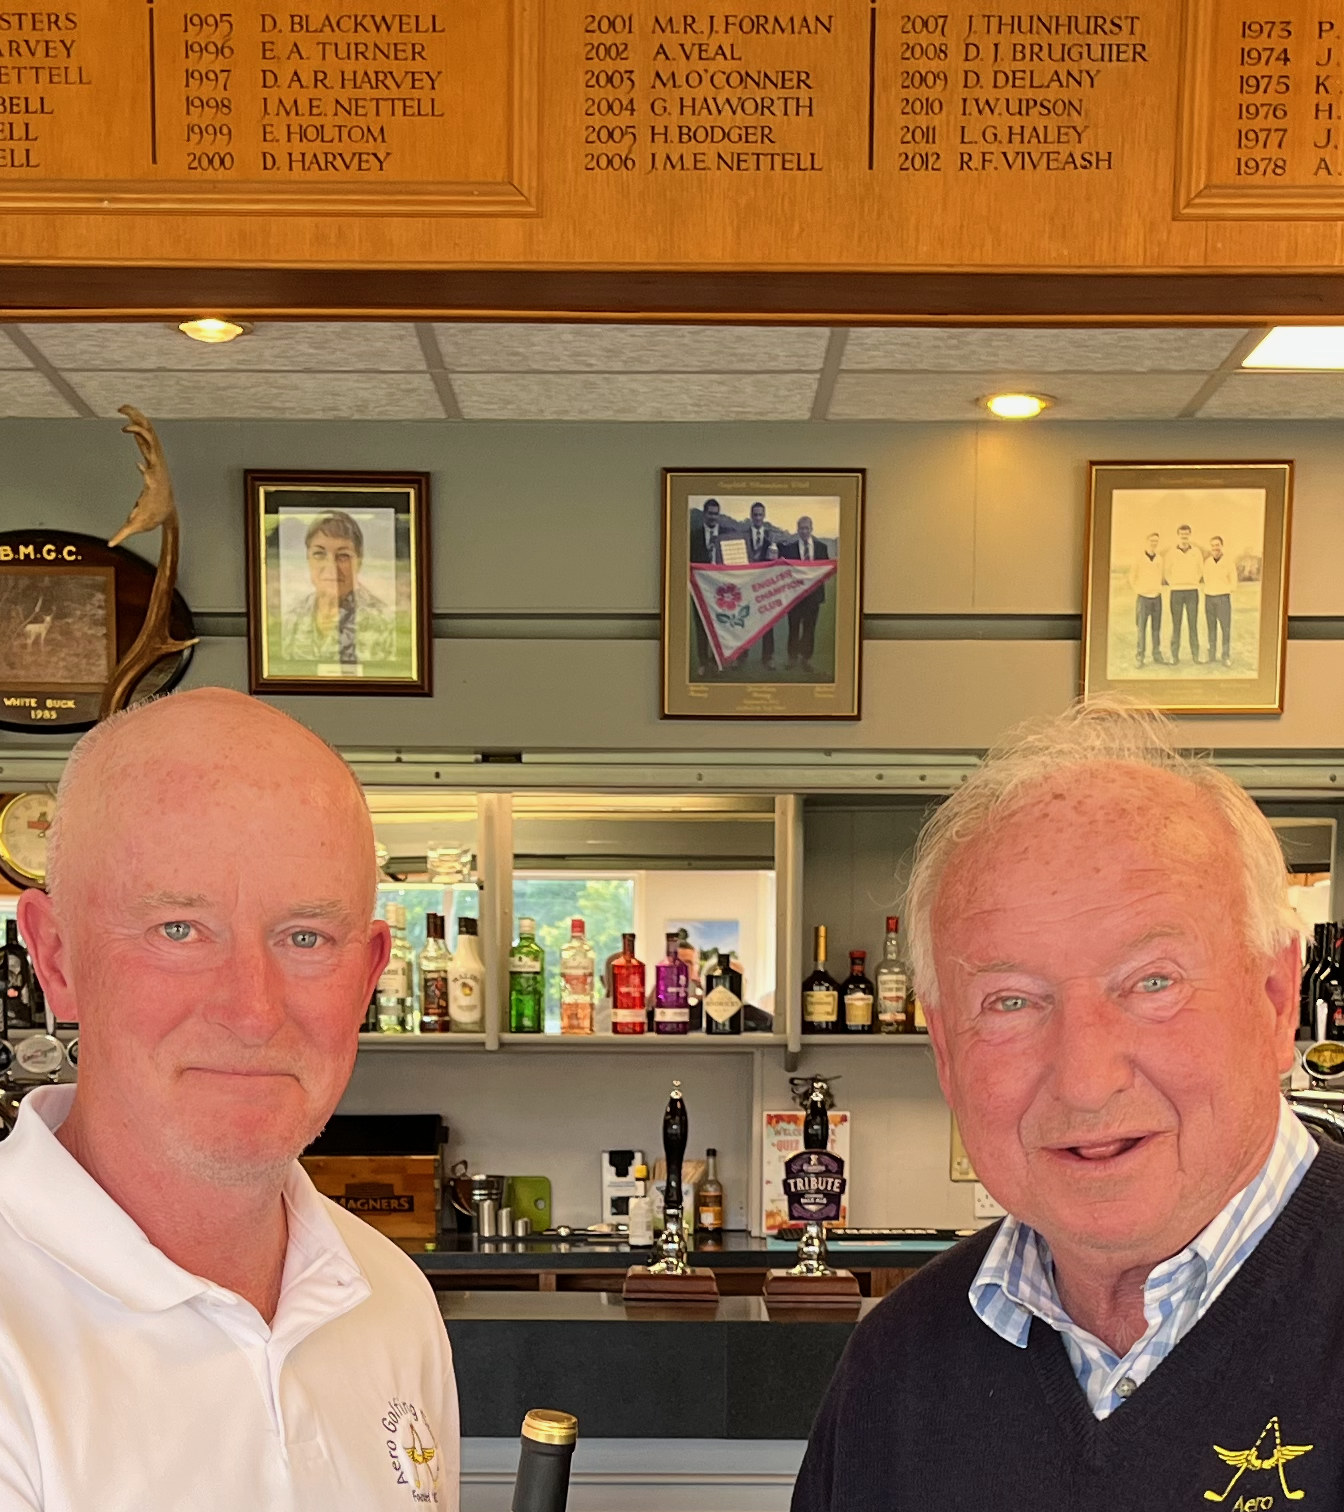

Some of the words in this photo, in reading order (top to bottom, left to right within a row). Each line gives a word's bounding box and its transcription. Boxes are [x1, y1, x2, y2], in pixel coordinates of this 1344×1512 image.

[183, 14, 234, 37] 1995
[584, 15, 633, 33] 2001
[901, 15, 948, 38] 2007
[1241, 20, 1292, 39] 1973
[185, 40, 234, 60] 1996
[584, 43, 629, 61] 2002
[900, 42, 948, 61] 2008
[1240, 48, 1291, 66] 1974
[185, 69, 231, 90] 1997
[584, 70, 635, 93] 2003
[900, 70, 948, 91] 2009
[1239, 75, 1290, 94] 1975
[186, 98, 231, 117] 1998
[585, 97, 636, 116] 2004
[900, 98, 943, 116] 2010
[1238, 103, 1288, 121] 1976
[186, 124, 232, 145] 1999
[585, 125, 636, 149] 2005
[900, 126, 937, 144] 2011
[1237, 129, 1287, 148] 1977
[188, 152, 234, 170] 2000
[585, 152, 636, 171] 2006
[899, 153, 941, 172] 2012
[1236, 156, 1286, 176] 1978
[0, 544, 82, 561] B.M.G.C.
[757, 599, 784, 615] CLUB
[4, 698, 37, 708] WHITE
[46, 699, 75, 708] BUCK
[787, 1176, 842, 1192] TRIBUTE
[387, 1440, 408, 1485] Aero
[1231, 1495, 1273, 1512] Aero
